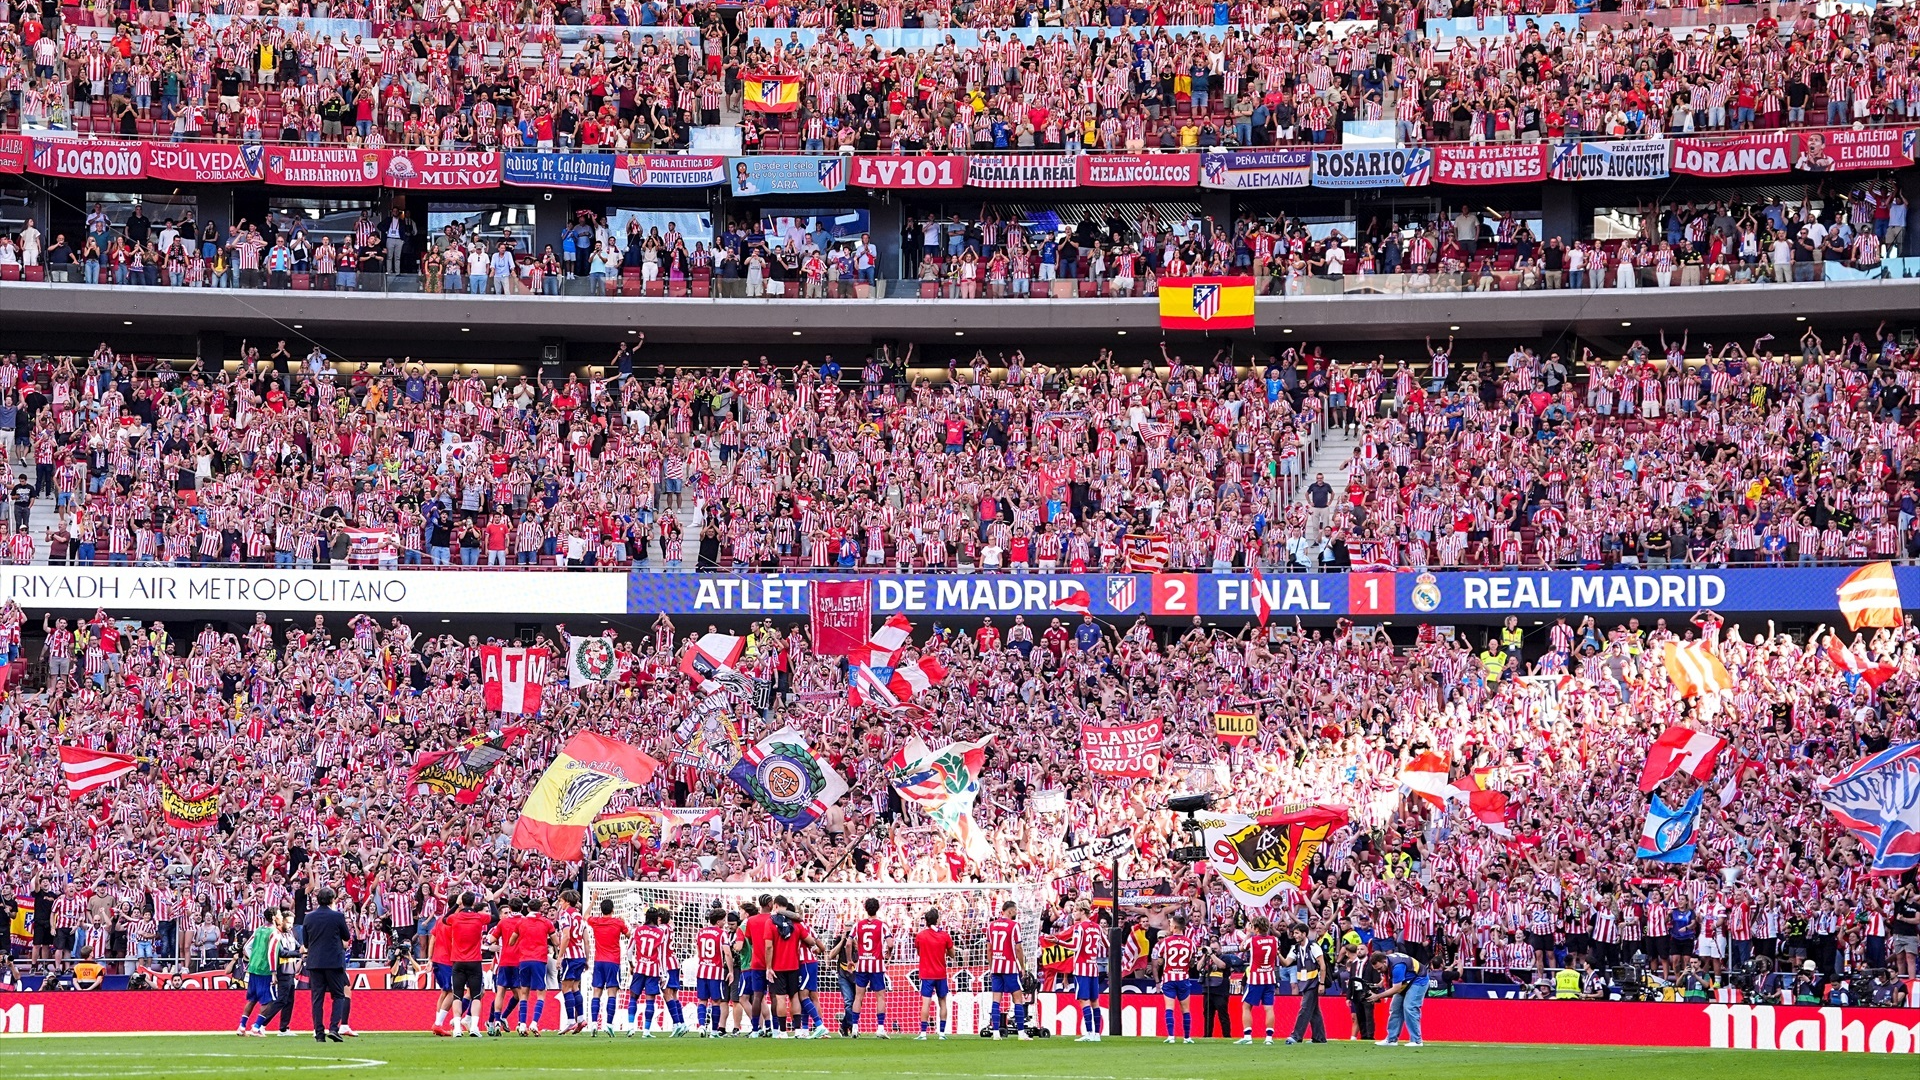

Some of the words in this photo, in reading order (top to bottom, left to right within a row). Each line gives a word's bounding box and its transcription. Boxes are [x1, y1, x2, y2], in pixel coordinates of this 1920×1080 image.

[1833, 132, 1856, 144] PEÑA
[1857, 129, 1898, 143] ATLÉTICA
[289, 149, 358, 163] ALDEANUEVA
[1441, 146, 1474, 160] PEÑA
[1478, 144, 1539, 159] ATLÉTICA
[1612, 144, 1630, 152] PEÑA
[1631, 143, 1665, 152] ATLÉTICA
[1841, 147, 1854, 160] EL
[1856, 145, 1890, 159] CHOLO
[57, 148, 142, 175] LOGROÑO
[150, 149, 246, 170] SEPÚLVEDA
[424, 152, 494, 168] PEDRO
[542, 157, 554, 172] de
[557, 156, 611, 177] Caledonia
[650, 158, 669, 168] PEÑA
[670, 157, 702, 168] ATLÉTICA
[703, 158, 713, 168] DE
[753, 162, 781, 171] Desde
[783, 162, 790, 170] el
[793, 162, 814, 170] cielo
[1109, 155, 1141, 163] ATLÉTICA
[1235, 154, 1257, 166] PEÑA
[1259, 153, 1290, 165] ATLÉTICA
[1293, 154, 1306, 164] DE
[1317, 151, 1405, 177] ROSARIO
[1563, 154, 1604, 178] LUCUS
[1607, 153, 1665, 177] AUGUSTI
[1674, 146, 1789, 173] LORANCA
[196, 170, 250, 180] ROJIBLANCA
[285, 168, 363, 182] BARBARROYA
[420, 168, 498, 185] MUÑOZ
[535, 172, 557, 180] SINCE
[560, 173, 578, 182] 2016
[650, 171, 713, 184] PONTEVEDRA
[751, 171, 760, 179] te
[762, 172, 776, 180] voy
[786, 170, 817, 179] animar
[857, 159, 953, 186] LV101
[969, 165, 1020, 180] ALCALÁ
[1023, 167, 1040, 180] LA
[1043, 166, 1076, 180] REAL
[1089, 161, 1191, 182] MELANCÓLICOS
[1438, 159, 1542, 180] PATONES
[770, 180, 799, 190] SARA
[1236, 172, 1303, 188] ALEMANIA
[13, 575, 119, 598] RIYADH
[129, 577, 177, 599] AIR
[189, 578, 407, 602] METROPOLITANO
[693, 574, 861, 610] ATLÉT
[879, 579, 926, 610] DE
[936, 579, 1085, 610] MADRID
[1164, 579, 1187, 609] 2
[1217, 578, 1331, 610] FINAL
[1364, 579, 1378, 609] 1
[1464, 577, 1562, 609] REAL
[1571, 574, 1726, 608] MADRID
[820, 596, 864, 612] APLASTA
[823, 612, 859, 627] ATLETI
[485, 654, 546, 686] ATM
[1085, 723, 1159, 745] BLANCO
[1218, 717, 1254, 732] LILLO
[1101, 745, 1121, 759] NI
[1127, 744, 1143, 758] EL
[1090, 754, 1157, 772] ORUJO
[641, 936, 655, 956] 11
[700, 937, 716, 958] 19
[862, 932, 873, 951] 5
[992, 931, 1007, 950] 17
[1085, 934, 1099, 954] 23
[1168, 947, 1190, 967] 22
[1261, 945, 1272, 965] 7
[1703, 1004, 1920, 1053] Maho
